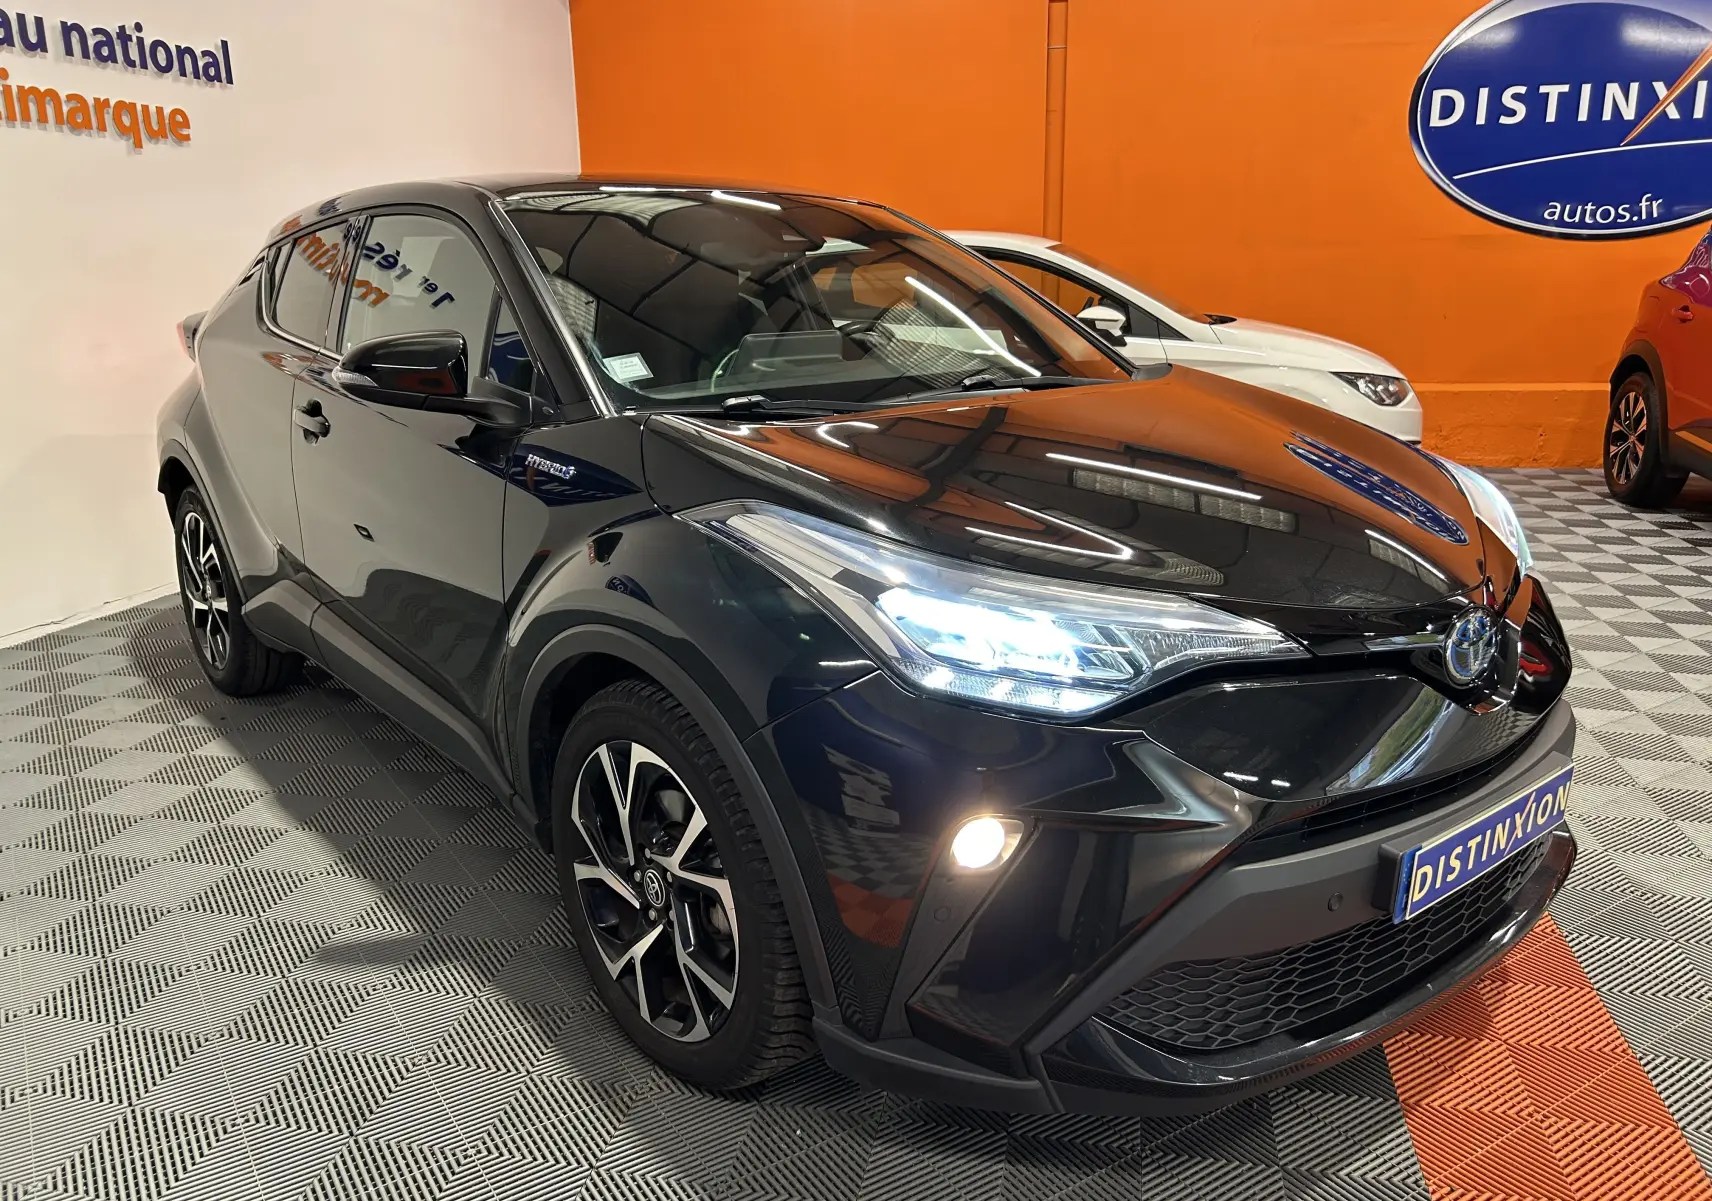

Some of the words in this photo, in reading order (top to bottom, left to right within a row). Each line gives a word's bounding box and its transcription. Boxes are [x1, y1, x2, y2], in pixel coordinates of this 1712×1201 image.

[60, 20, 234, 85] national
[0, 67, 191, 149] imarque
[1543, 193, 1663, 224] autos.fr
[1412, 781, 1570, 903] DISTINXION
